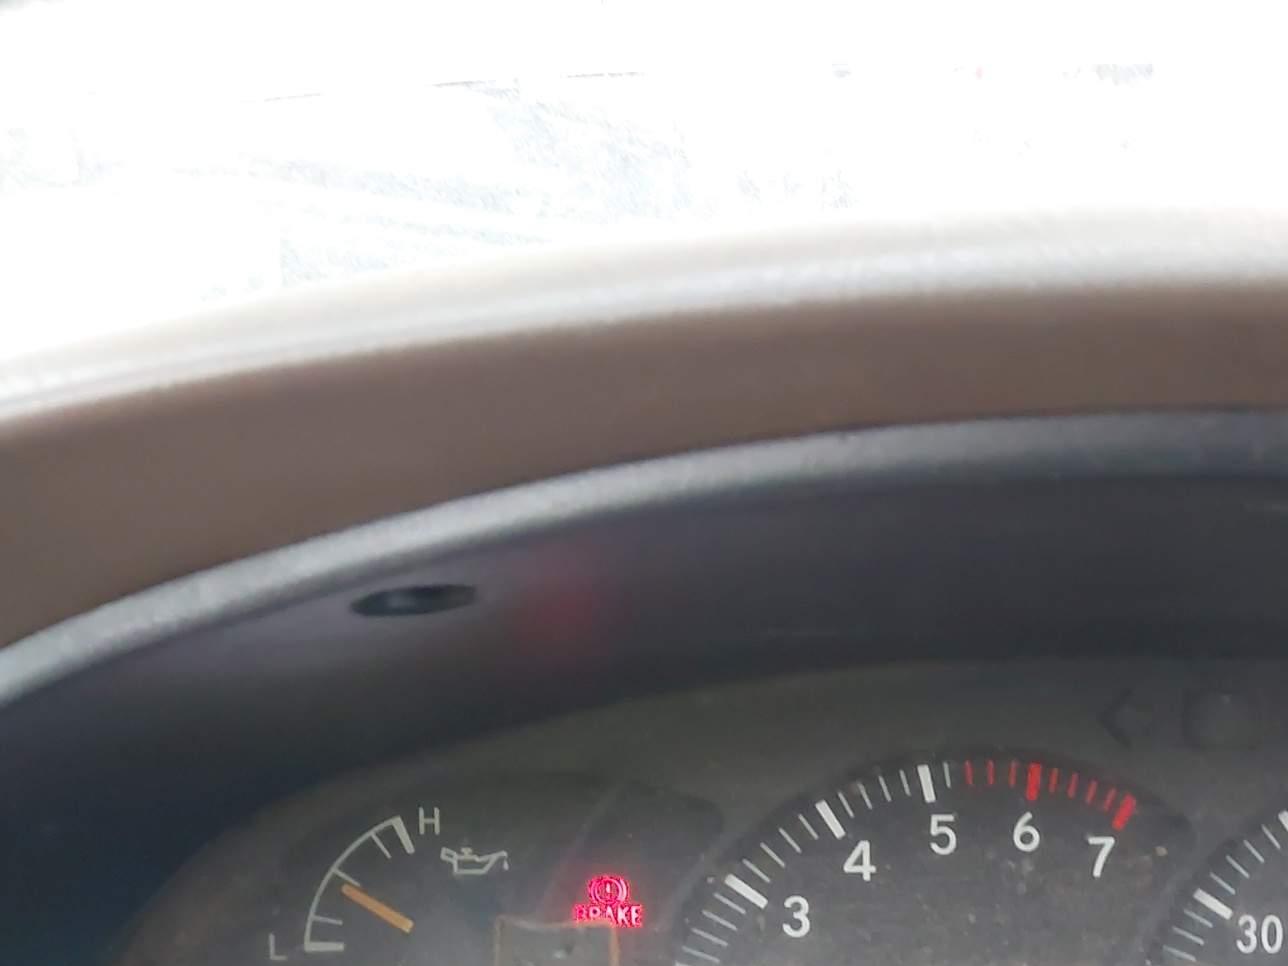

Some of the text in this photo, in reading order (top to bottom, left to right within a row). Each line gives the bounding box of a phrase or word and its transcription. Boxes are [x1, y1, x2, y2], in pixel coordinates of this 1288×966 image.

[418, 807, 441, 835] H
[930, 814, 957, 855] 5
[1013, 812, 1040, 852] 6
[844, 840, 876, 881] 4
[1088, 836, 1116, 877] 7
[574, 904, 642, 927] BRAKE
[782, 896, 811, 937] 3
[1236, 914, 1283, 954] 30
[269, 934, 287, 961] L
